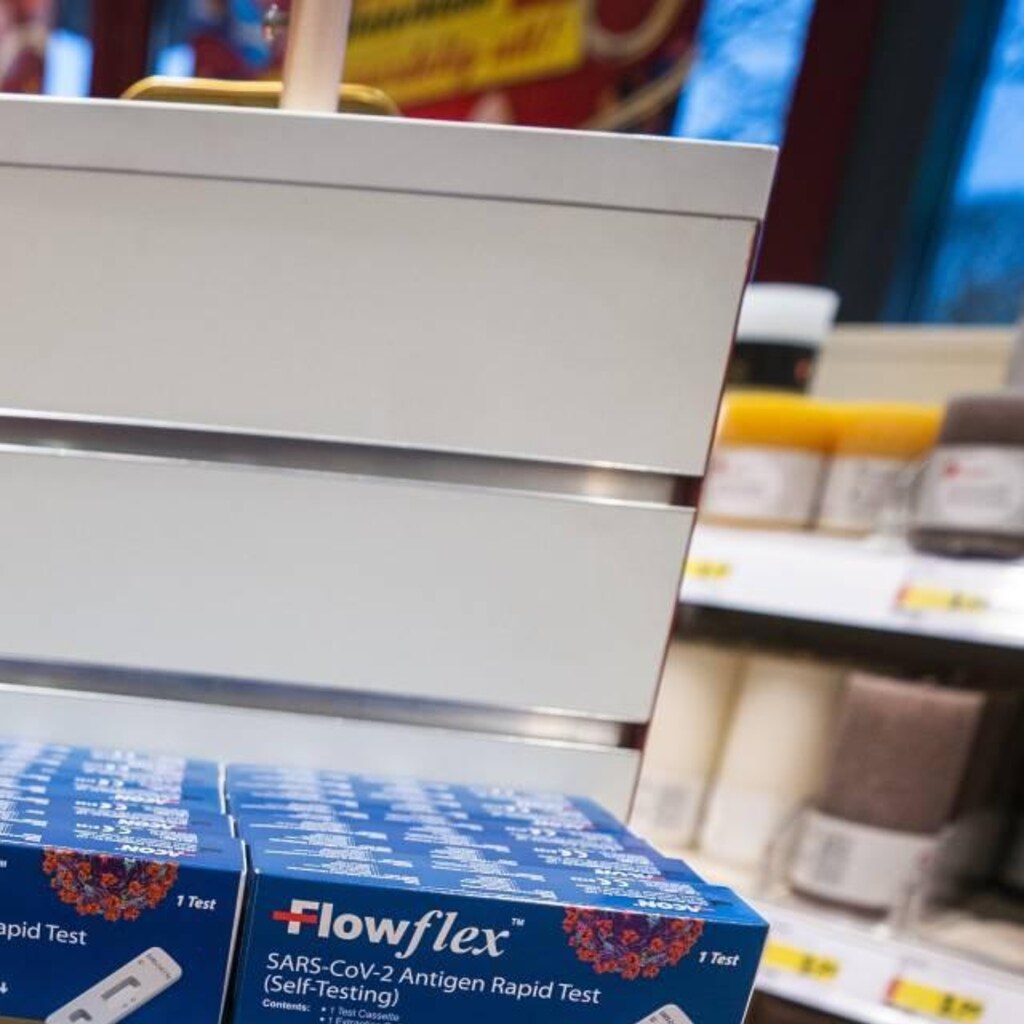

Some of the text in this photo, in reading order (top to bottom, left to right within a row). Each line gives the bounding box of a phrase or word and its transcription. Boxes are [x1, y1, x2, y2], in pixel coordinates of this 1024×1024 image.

[177, 895, 216, 910] 1 Test
[45, 924, 87, 945] Test
[273, 899, 510, 959] Flowflex
[699, 951, 739, 966] 1 Test
[267, 953, 601, 1004] SARS-CoV-2 Antigen Rapid Test
[264, 974, 399, 1008] (Self-Testing)
[262, 998, 310, 1012] Contents:
[338, 1007, 357, 1017] Test
